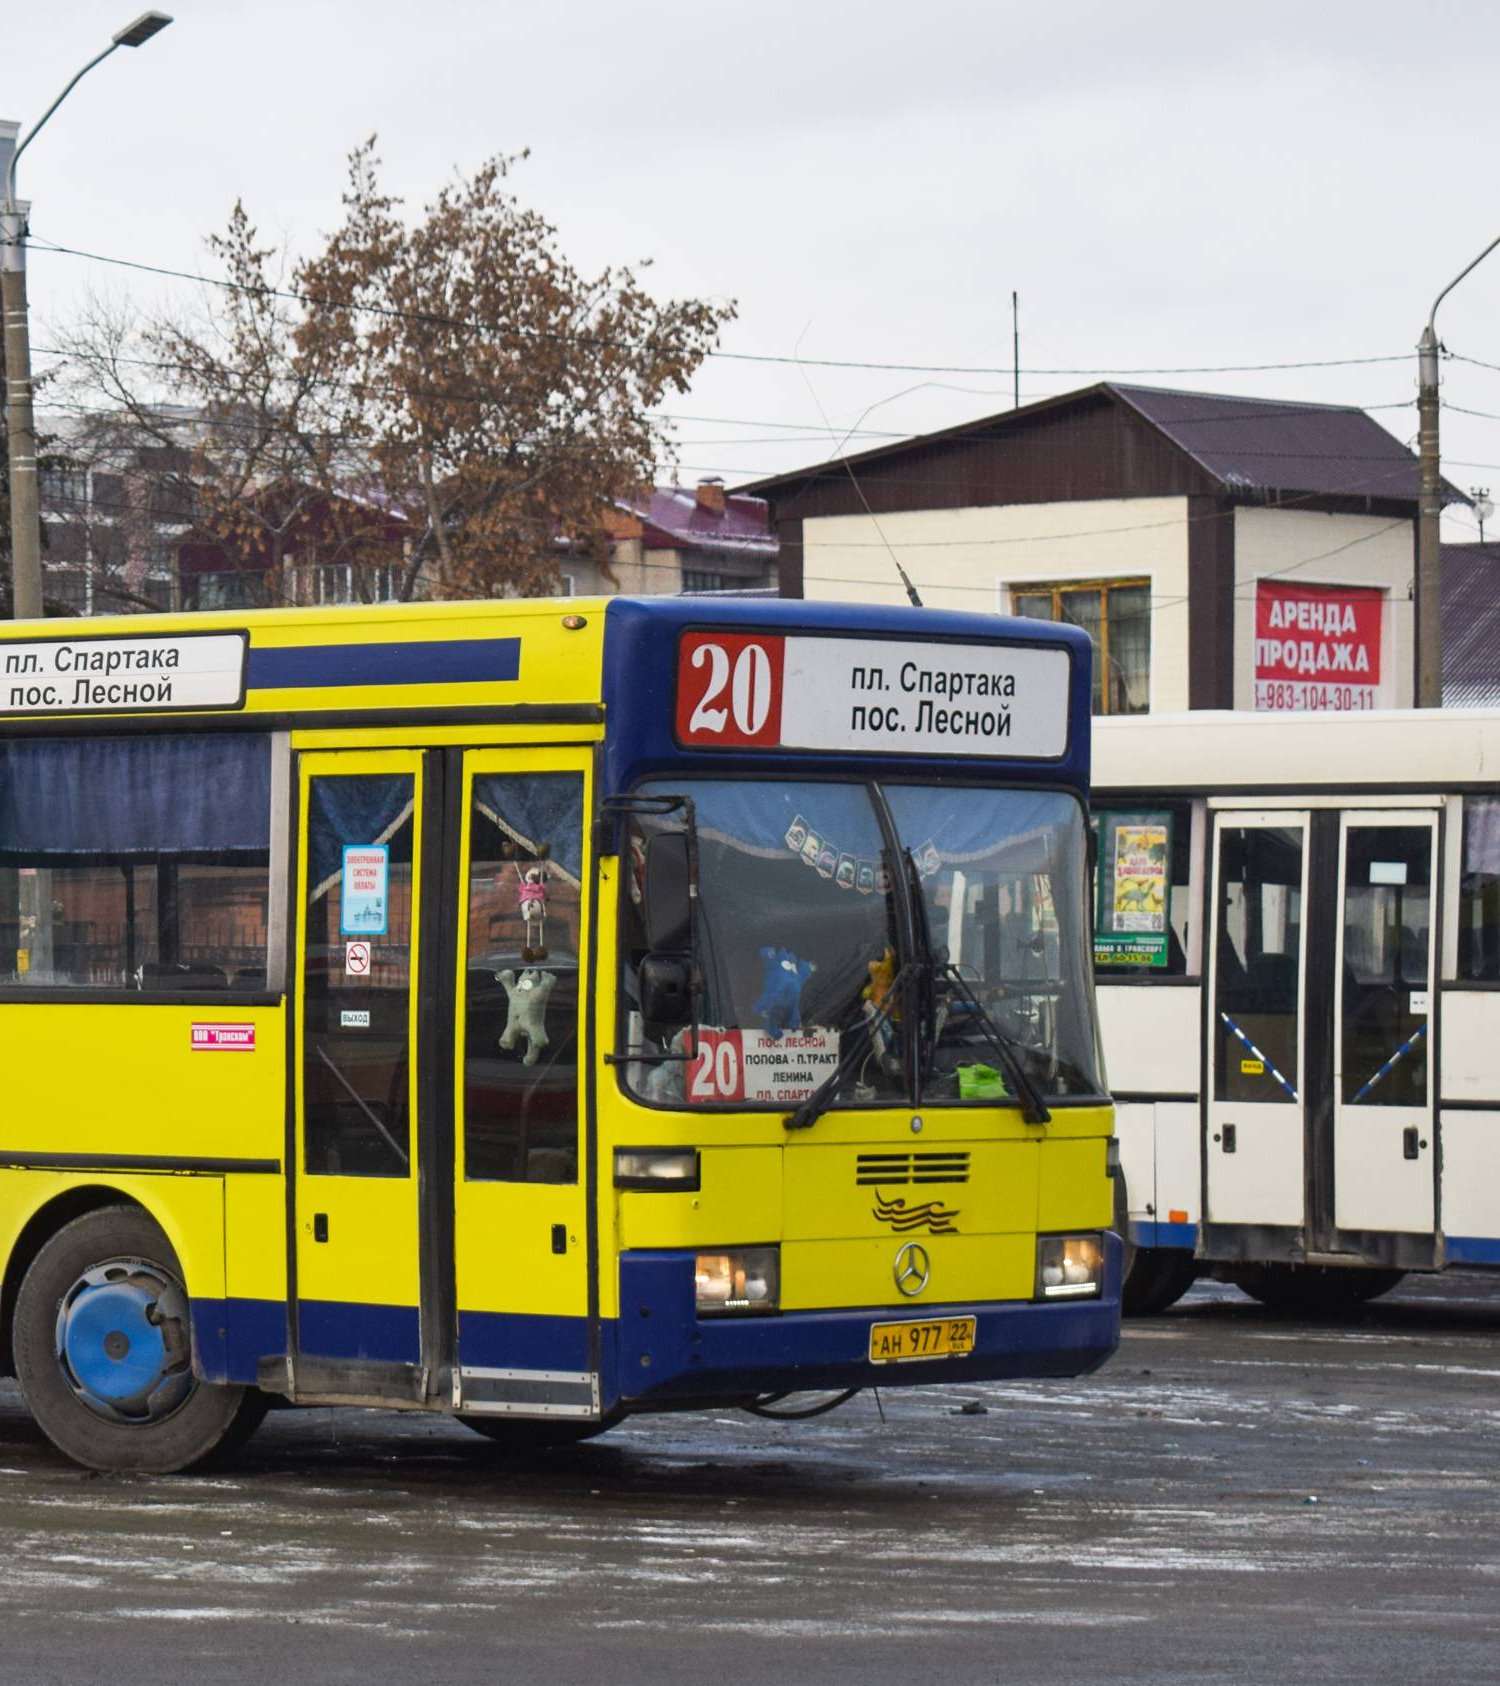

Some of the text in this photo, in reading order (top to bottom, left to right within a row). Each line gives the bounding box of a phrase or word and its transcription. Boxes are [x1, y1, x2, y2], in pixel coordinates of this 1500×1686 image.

[1269, 600, 1357, 636] АРЕНДА
[5, 646, 179, 675] пл. Спартака
[1256, 638, 1369, 674] ПРОДАЖА
[10, 675, 172, 706] пос. Лесной
[690, 644, 771, 735] 20
[851, 662, 1016, 701] пл. Спартака
[851, 701, 1012, 736] пос. Лесной
[342, 1014, 368, 1024] ВЫХОД
[757, 1036, 826, 1048] ПОС. ЛЕСНОЙ
[691, 1041, 738, 1096] 20
[745, 1054, 789, 1065] ПОПОВА
[797, 1054, 838, 1065] П.ТРАКТ
[773, 1072, 814, 1083] ЛЕНИНА
[880, 1323, 968, 1355] АН 977 22
